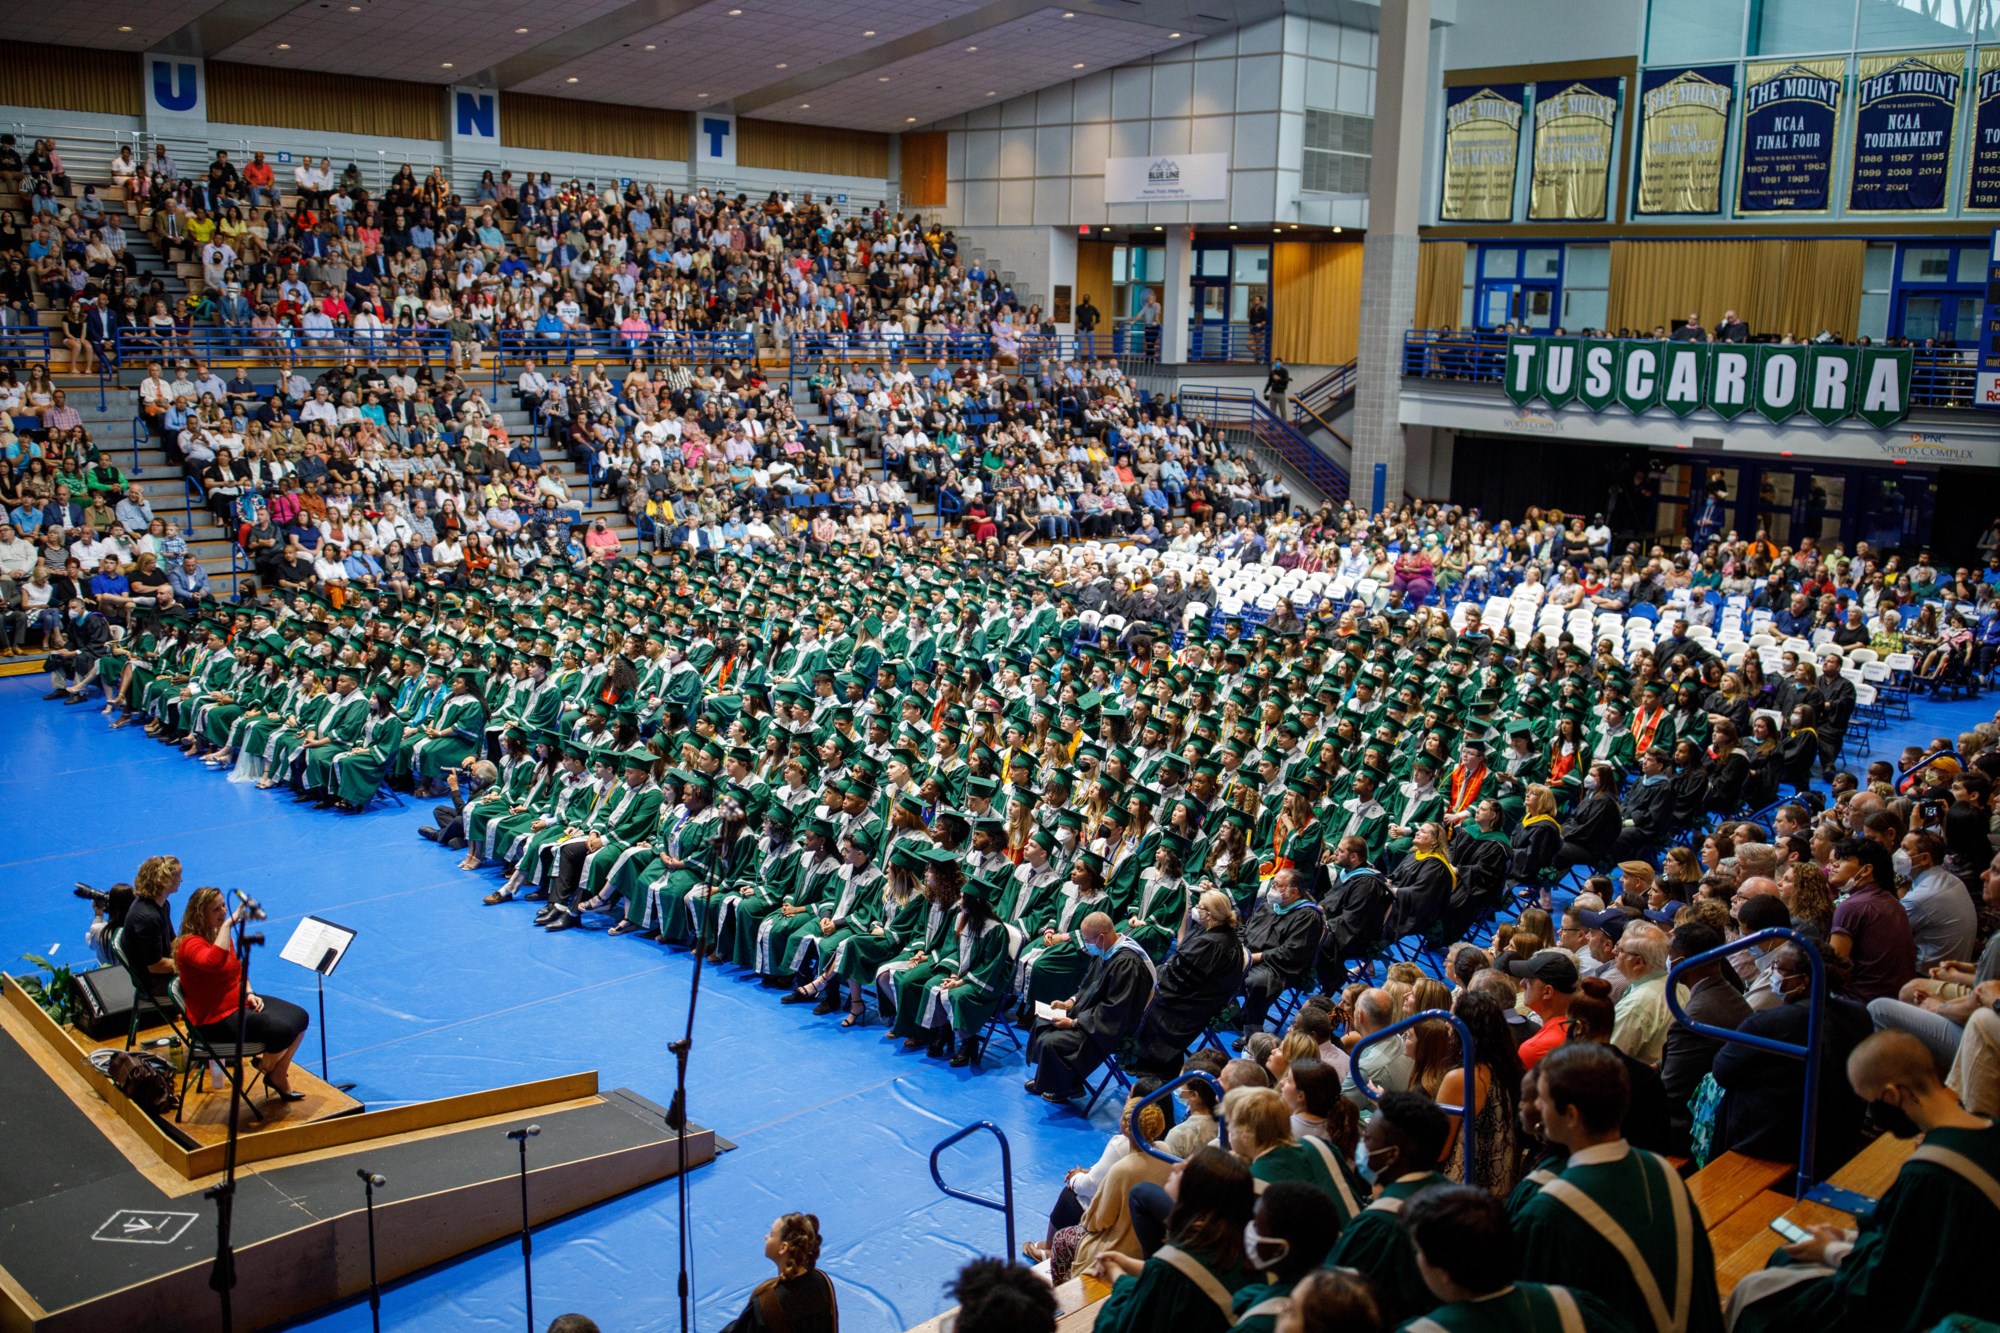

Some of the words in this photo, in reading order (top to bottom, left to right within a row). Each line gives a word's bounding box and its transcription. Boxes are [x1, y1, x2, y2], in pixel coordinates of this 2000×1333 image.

[1749, 81, 1780, 111] THE
[1783, 78, 1839, 106] MOUNT
[1861, 74, 1895, 105] THE
[1898, 72, 1958, 101] MOUNT
[1647, 88, 1674, 115] THE
[1679, 85, 1729, 111] MOUNT
[153, 61, 197, 111] U
[456, 92, 494, 137] N
[703, 118, 730, 157] T
[1538, 98, 1565, 126] THE
[1567, 96, 1613, 123] MOUNT
[1774, 116, 1804, 132] NCAA
[1887, 113, 1921, 130] NCAA
[1649, 139, 1717, 155] TOURNAMENT
[1756, 134, 1788, 150] FINAL
[1792, 133, 1820, 148] FOUR
[1864, 131, 1943, 148] TOURNAMENT
[1890, 154, 1914, 162] 1987
[1921, 152, 1945, 160] 1995
[1166, 170, 1180, 178] LINE
[1804, 162, 1826, 170] 1962
[1858, 169, 1882, 177] 1999
[1887, 168, 1912, 176] 2008
[1918, 168, 1942, 176] 2014
[1772, 198, 1795, 206] 1982
[290, 338, 296, 348] 6
[1513, 345, 1900, 412] TUSCARORA
[1923, 433, 1946, 444] PNC
[1881, 445, 1919, 456] SPORTS
[1921, 446, 1974, 459] COMPLEX
